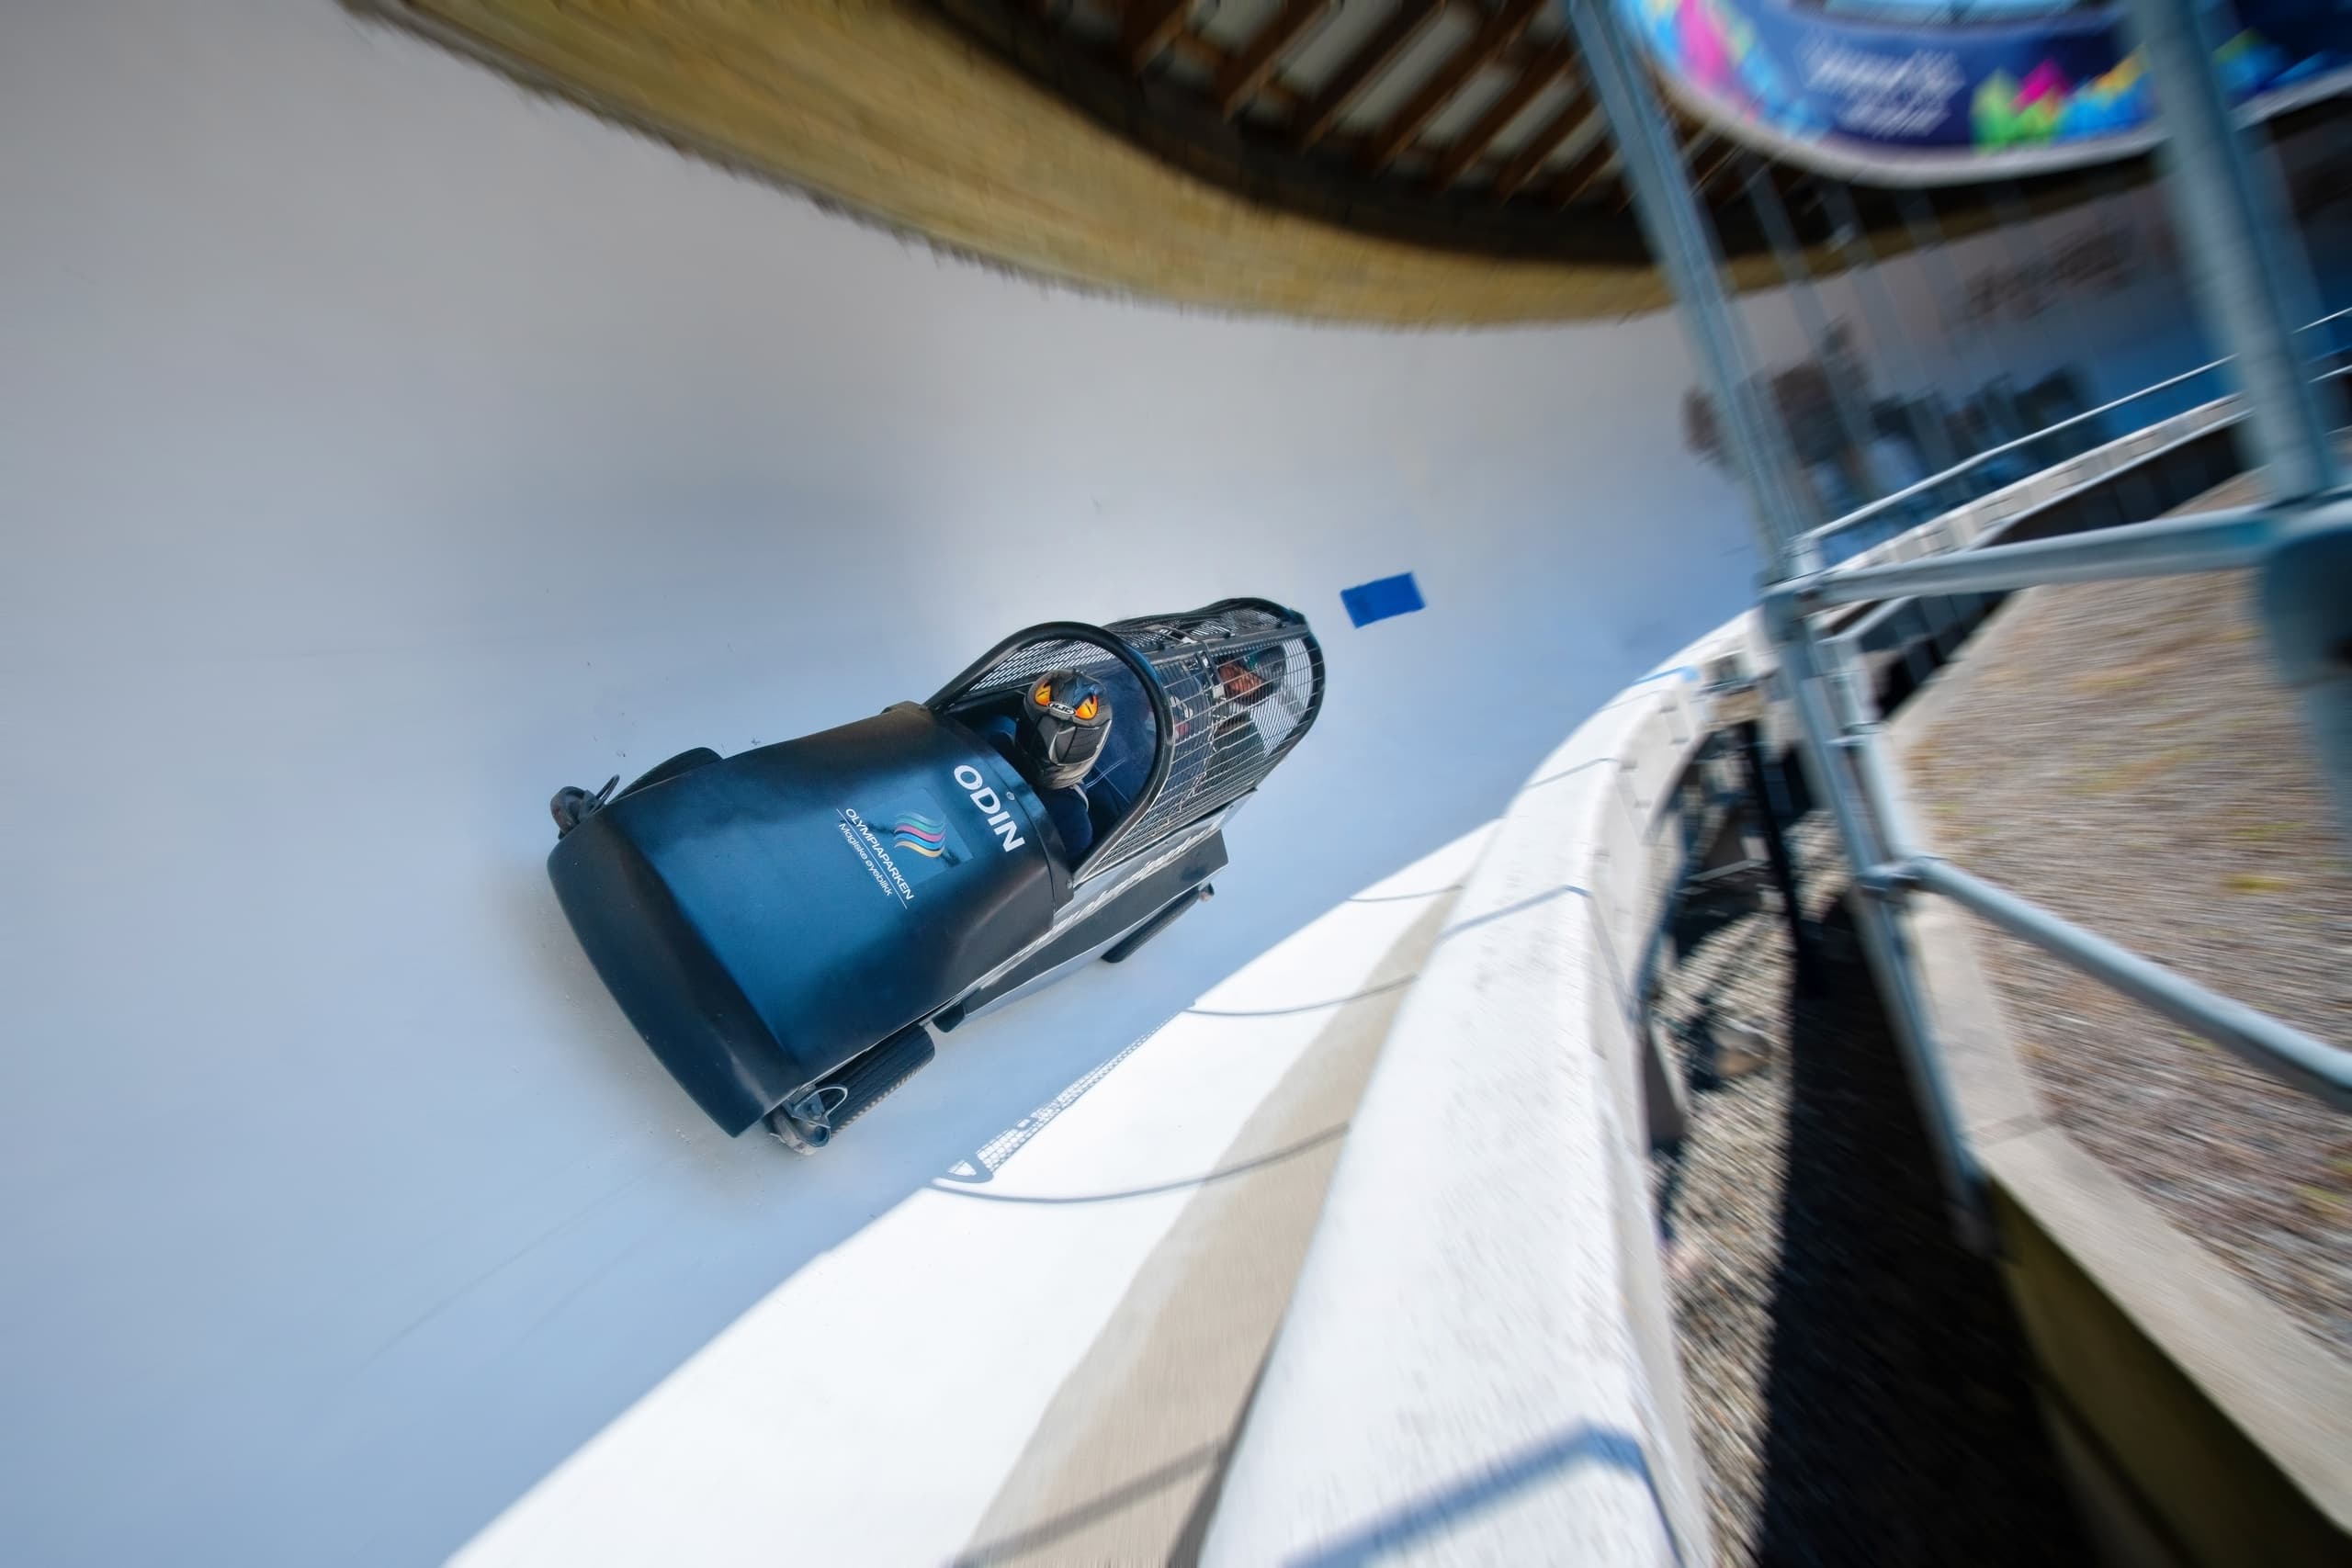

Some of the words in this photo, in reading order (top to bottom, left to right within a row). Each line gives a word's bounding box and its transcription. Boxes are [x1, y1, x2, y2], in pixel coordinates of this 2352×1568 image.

[1051, 703, 1073, 715] HJC
[954, 764, 1025, 852] ODIN
[838, 822, 868, 860] Magiske
[865, 860, 893, 897] øyeblikk
[845, 808, 914, 900] OLYMPIAPARKEN
